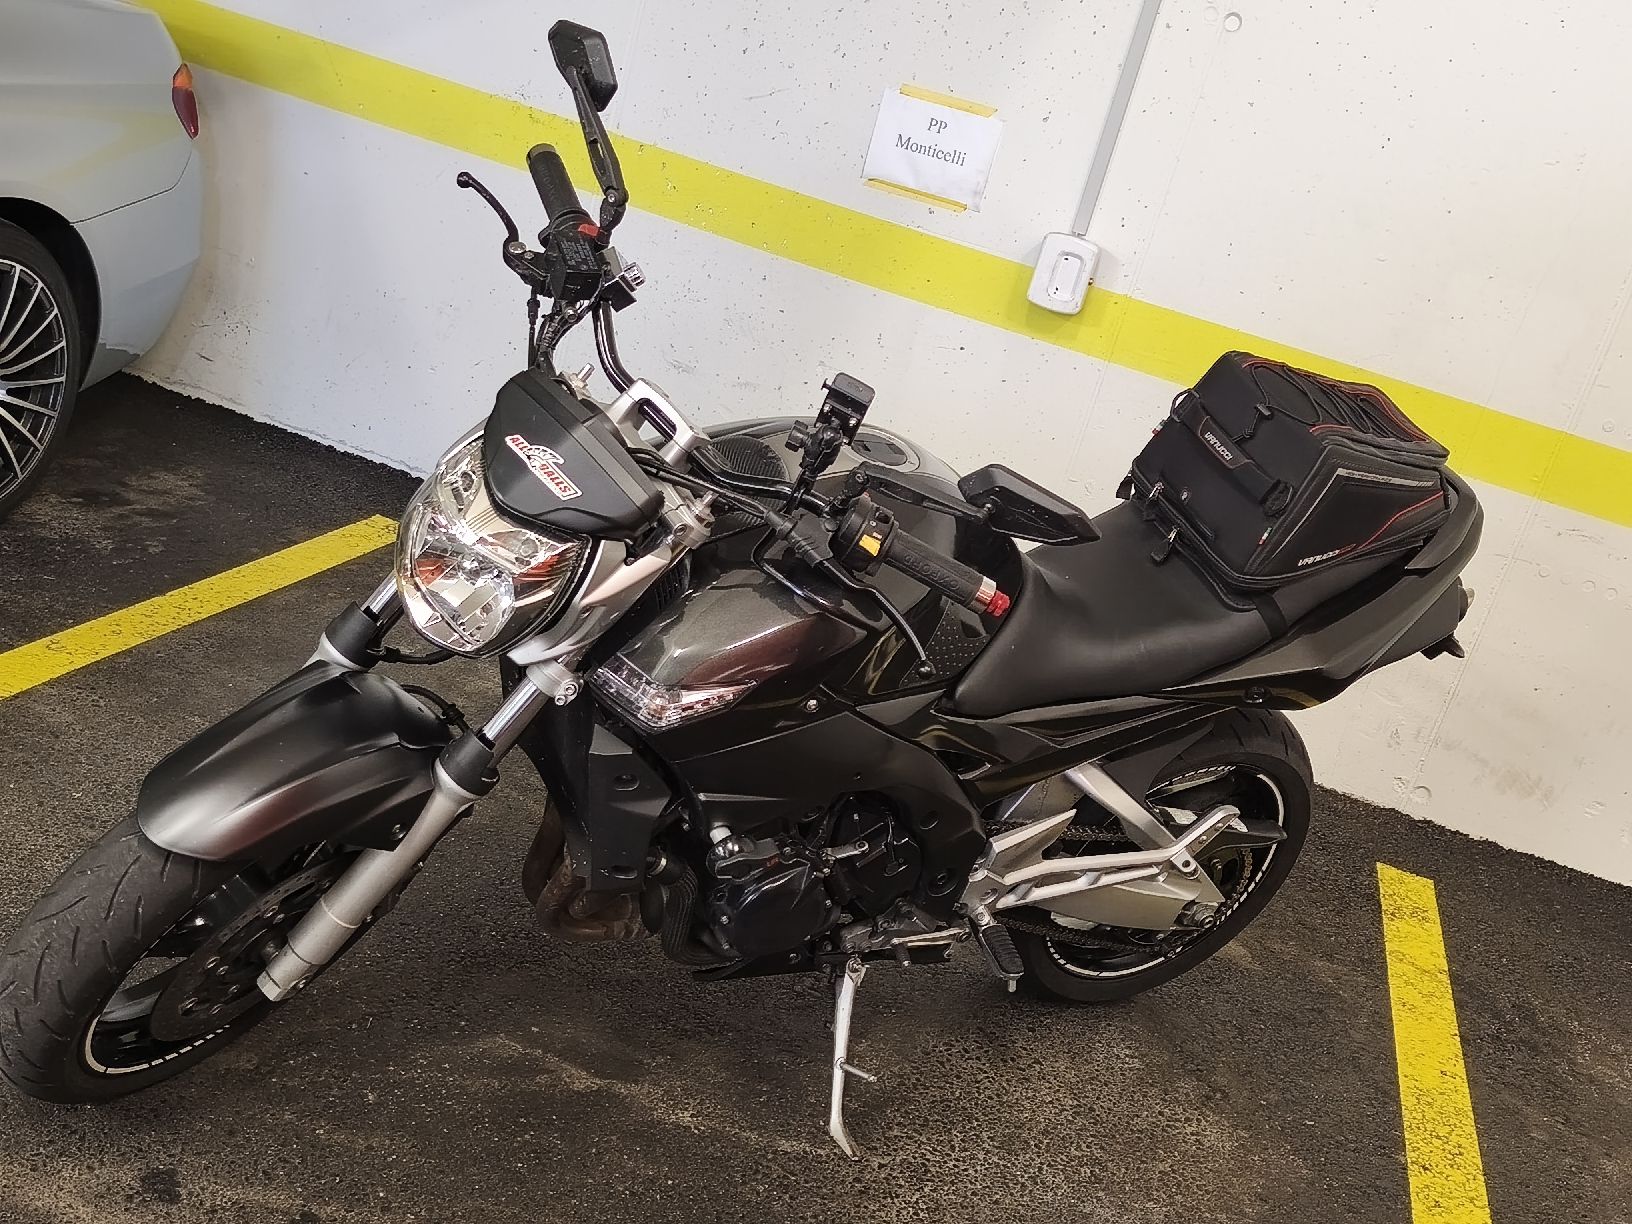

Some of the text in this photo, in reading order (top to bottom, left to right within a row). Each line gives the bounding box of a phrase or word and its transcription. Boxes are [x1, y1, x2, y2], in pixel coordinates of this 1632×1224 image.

[927, 117, 948, 134] PP
[895, 133, 967, 167] Monticelli
[510, 437, 529, 452] ALL
[1204, 431, 1233, 460] VANUCCI
[903, 554, 960, 590] OXFORD
